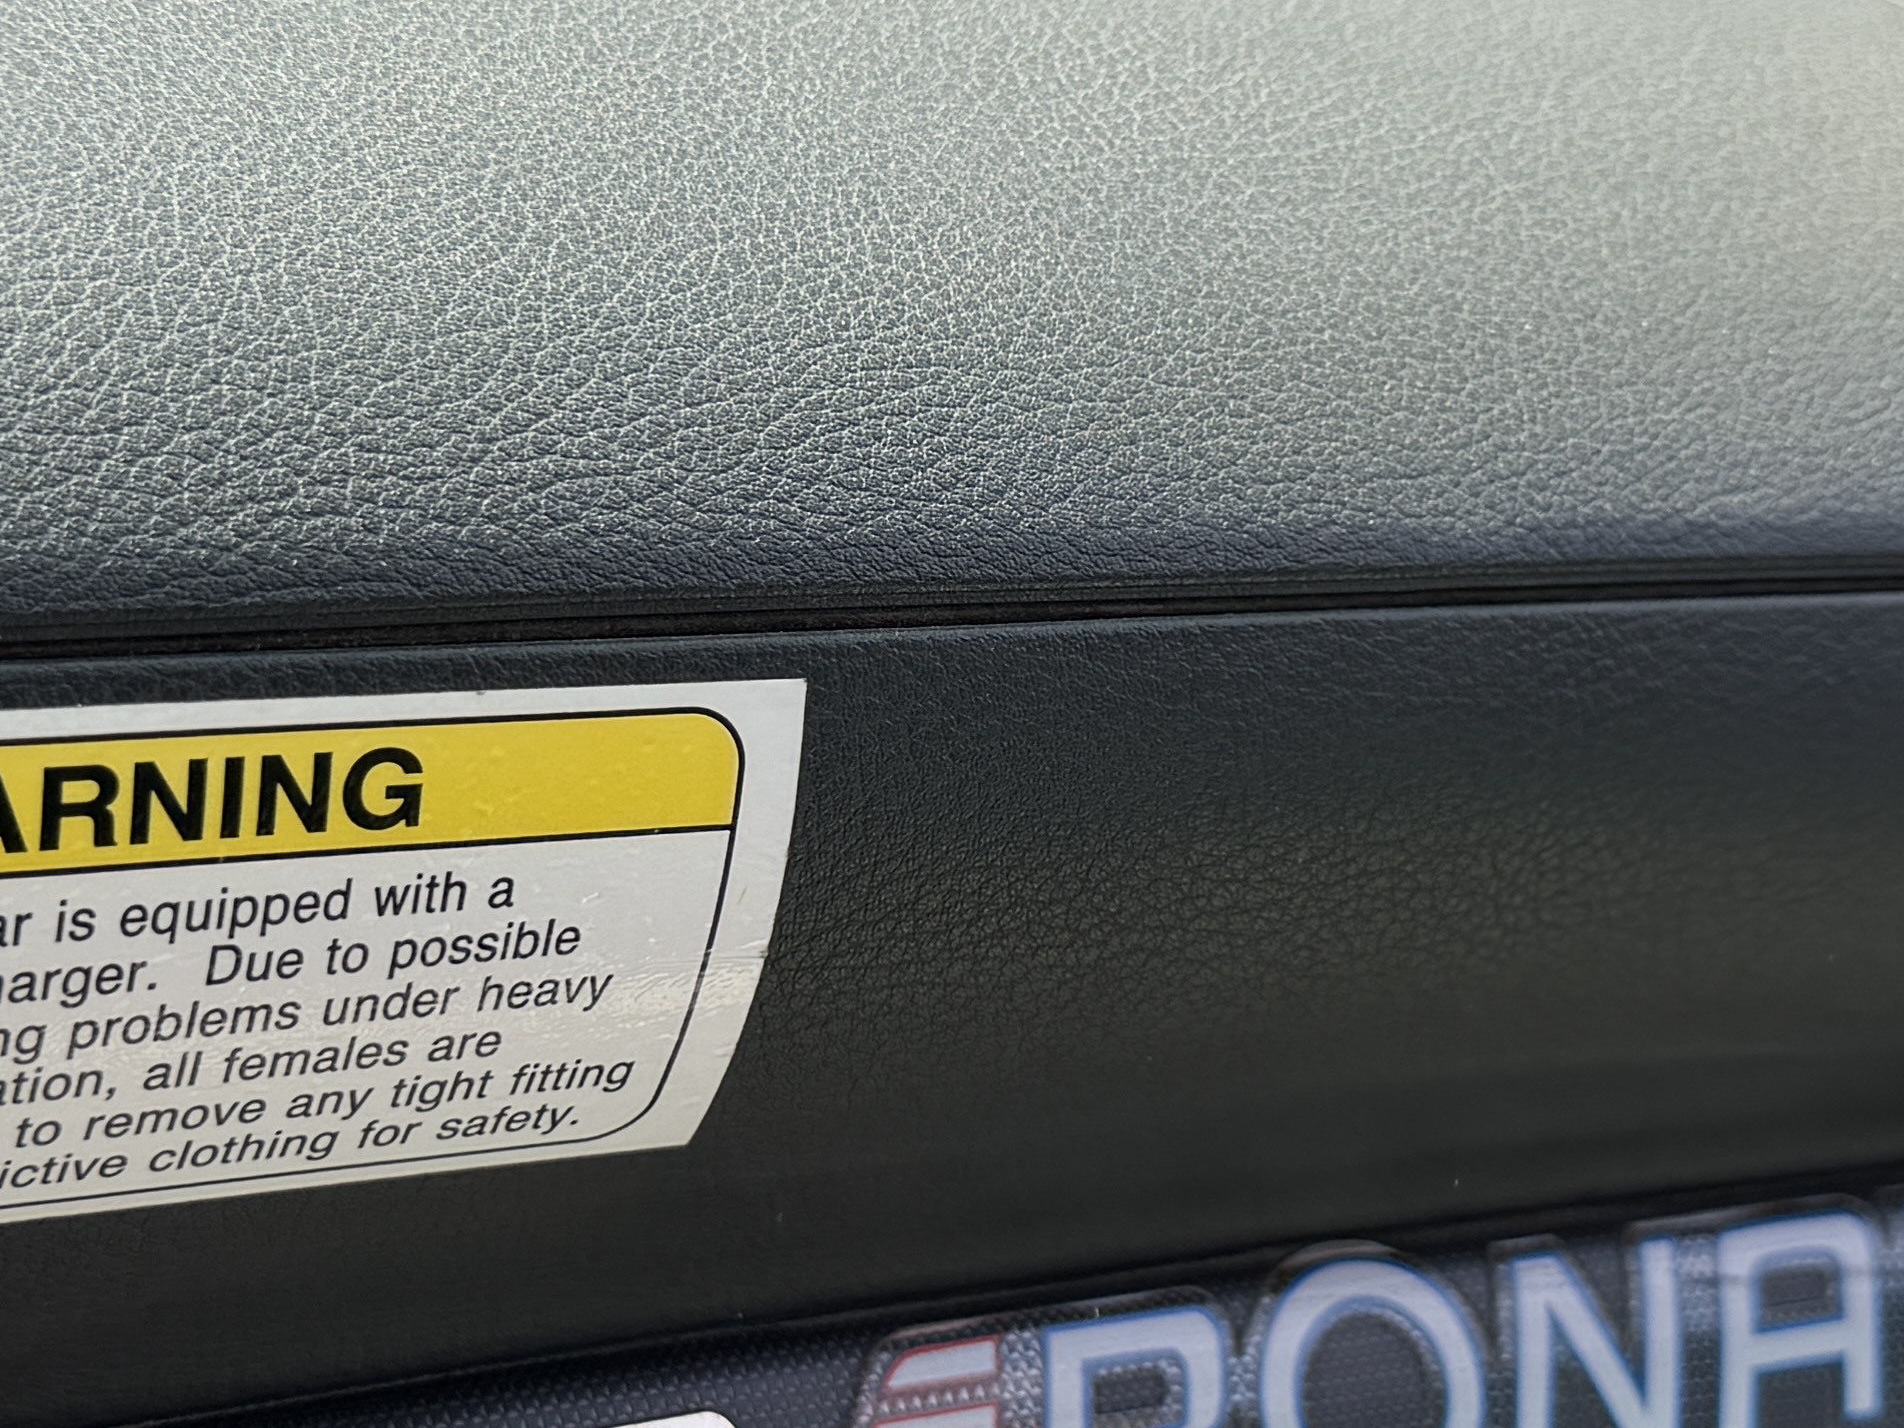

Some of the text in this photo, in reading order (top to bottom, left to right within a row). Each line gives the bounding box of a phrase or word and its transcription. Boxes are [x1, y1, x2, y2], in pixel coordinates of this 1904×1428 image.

[53, 897, 98, 945] is
[118, 876, 354, 947] equipped
[372, 869, 469, 919] with
[486, 875, 516, 911] a
[203, 943, 306, 988] Due
[325, 936, 371, 977] to
[385, 916, 583, 982] possible
[64, 999, 303, 1062] problems
[321, 980, 462, 1028] under
[475, 972, 616, 1014] heavy
[141, 1049, 205, 1093] all
[221, 1034, 411, 1085] females
[425, 1029, 504, 1064] are
[13, 1116, 64, 1150] to
[81, 1097, 268, 1142] remove
[284, 1086, 376, 1122] any
[389, 1068, 496, 1114] tight
[508, 1057, 637, 1097] fitting
[147, 1128, 341, 1174] clothing
[356, 1118, 424, 1151] for
[434, 1102, 580, 1142] safety.
